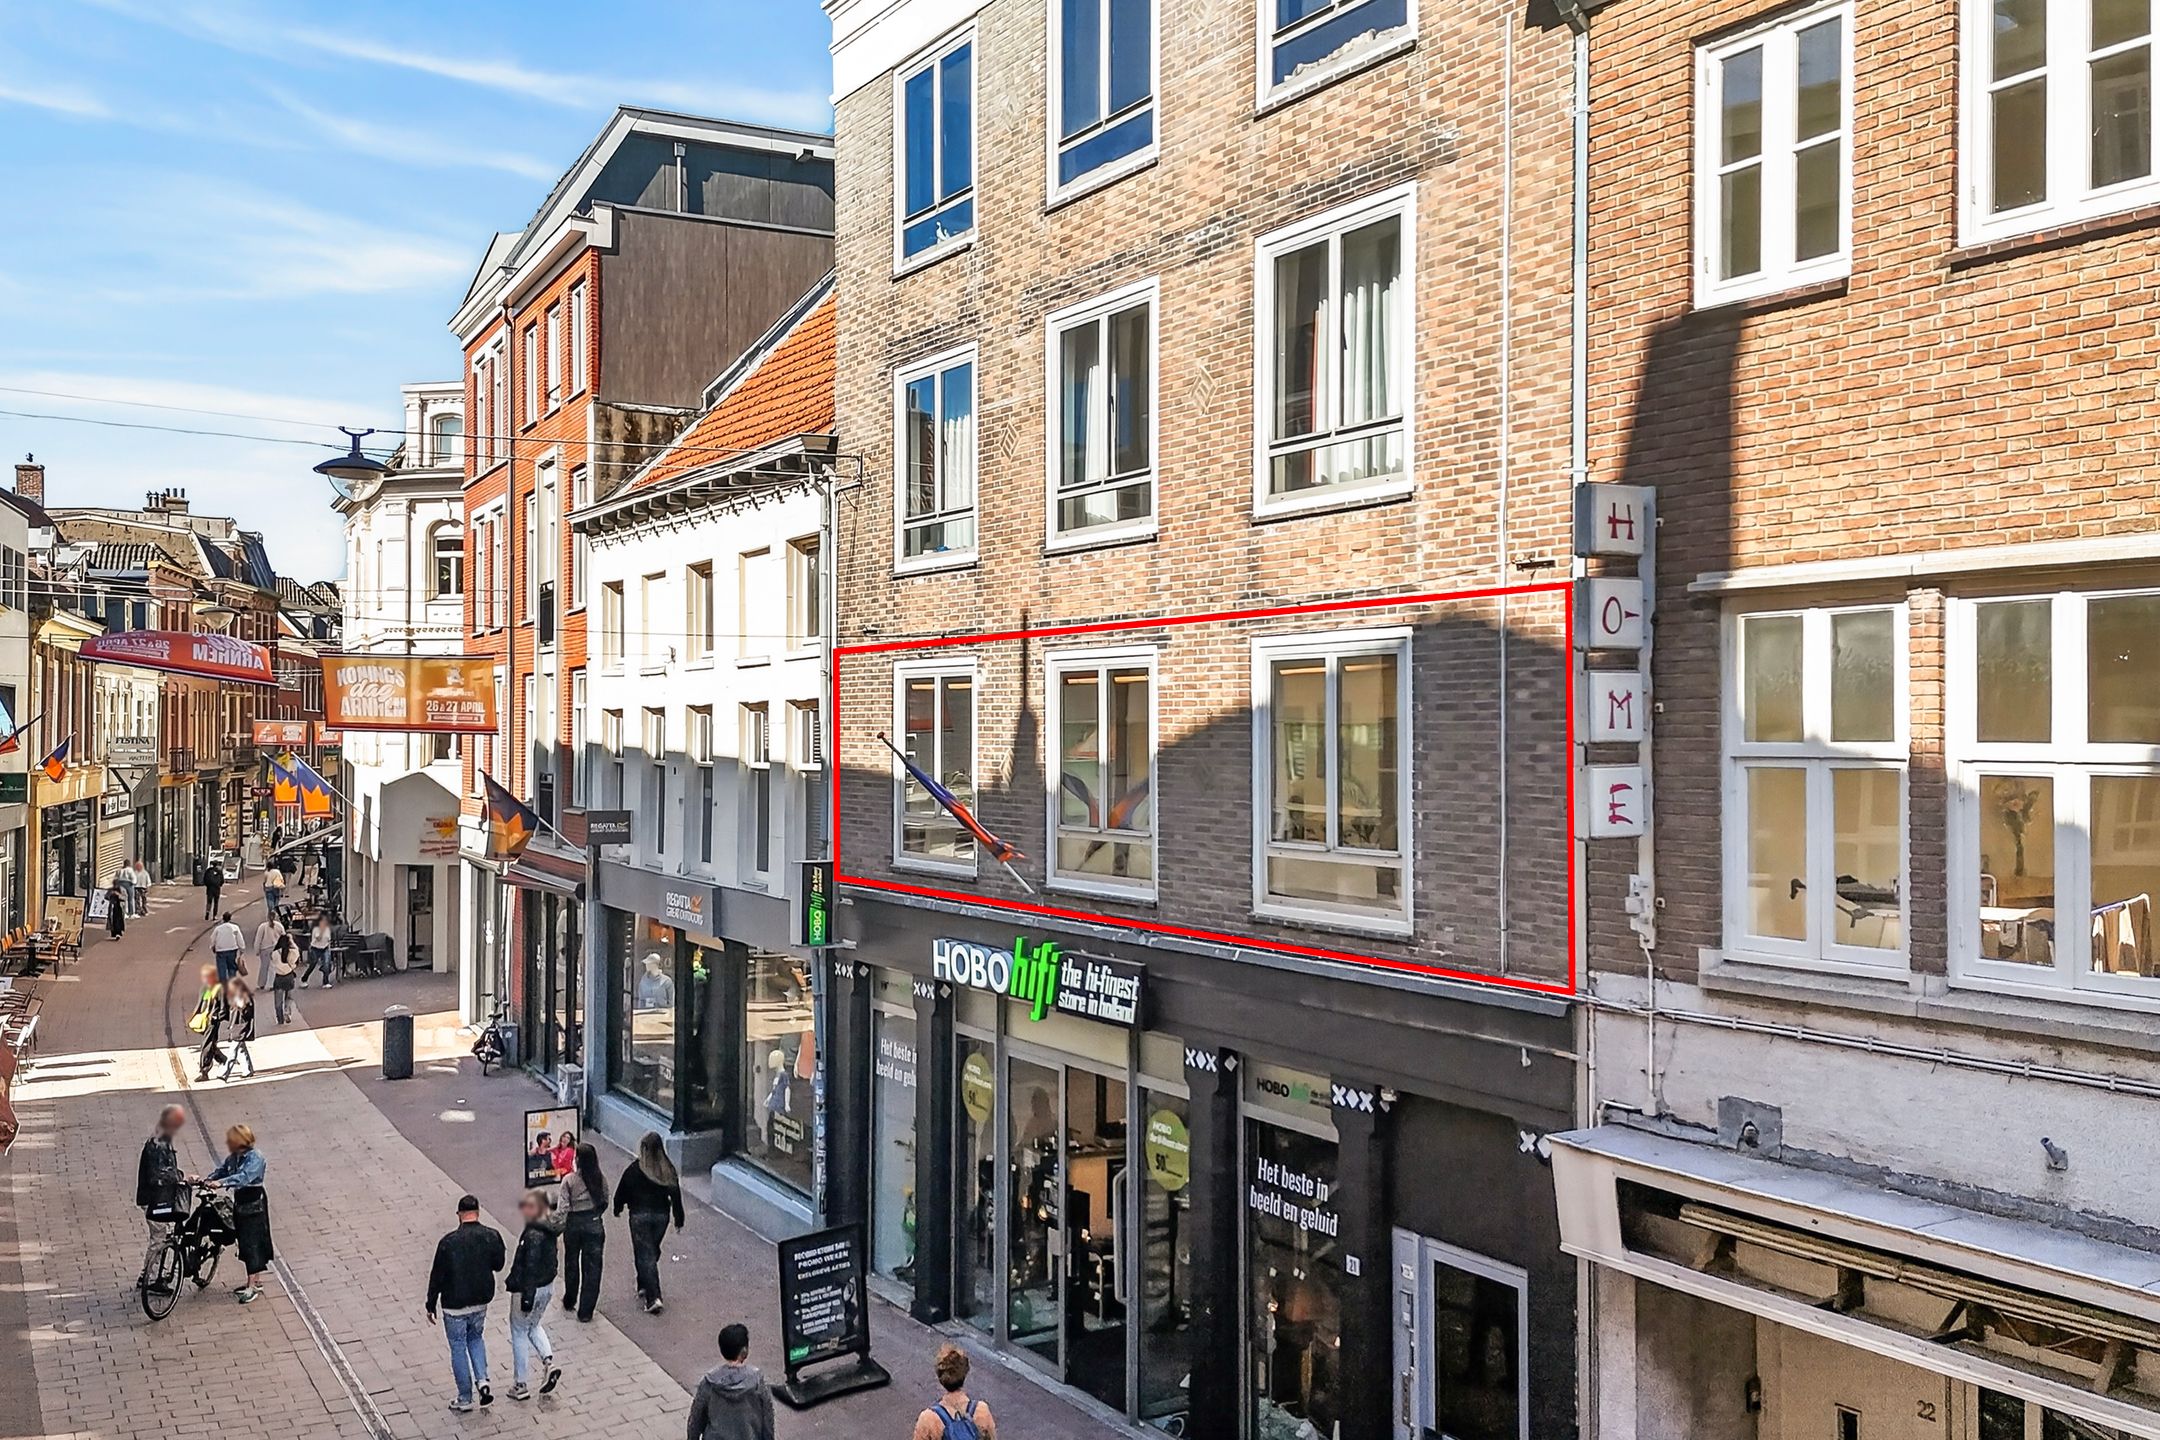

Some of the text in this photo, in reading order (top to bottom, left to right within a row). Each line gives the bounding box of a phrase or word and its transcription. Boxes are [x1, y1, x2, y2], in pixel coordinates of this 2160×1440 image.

[336, 664, 406, 688] KONINGS
[349, 679, 396, 703] dag
[340, 696, 407, 718] ARNHEM
[426, 700, 438, 712] 26
[445, 701, 457, 713] 27
[460, 701, 485, 713] APRIL
[116, 737, 150, 745] FESTINA
[665, 891, 691, 910] REGATTA
[813, 910, 822, 941] HOBO
[932, 936, 1063, 1023] HOBO hifi
[1061, 958, 1140, 1001] the hi-finest
[1058, 989, 1136, 1024] store in holland
[881, 1038, 894, 1058] Het
[893, 1041, 911, 1063] beste
[876, 1058, 894, 1079] beeld
[1256, 1077, 1290, 1099] HOBO
[1257, 1157, 1329, 1202] Het beste in
[1250, 1184, 1338, 1237] beeld en geluid
[1916, 1399, 1937, 1423] 22
